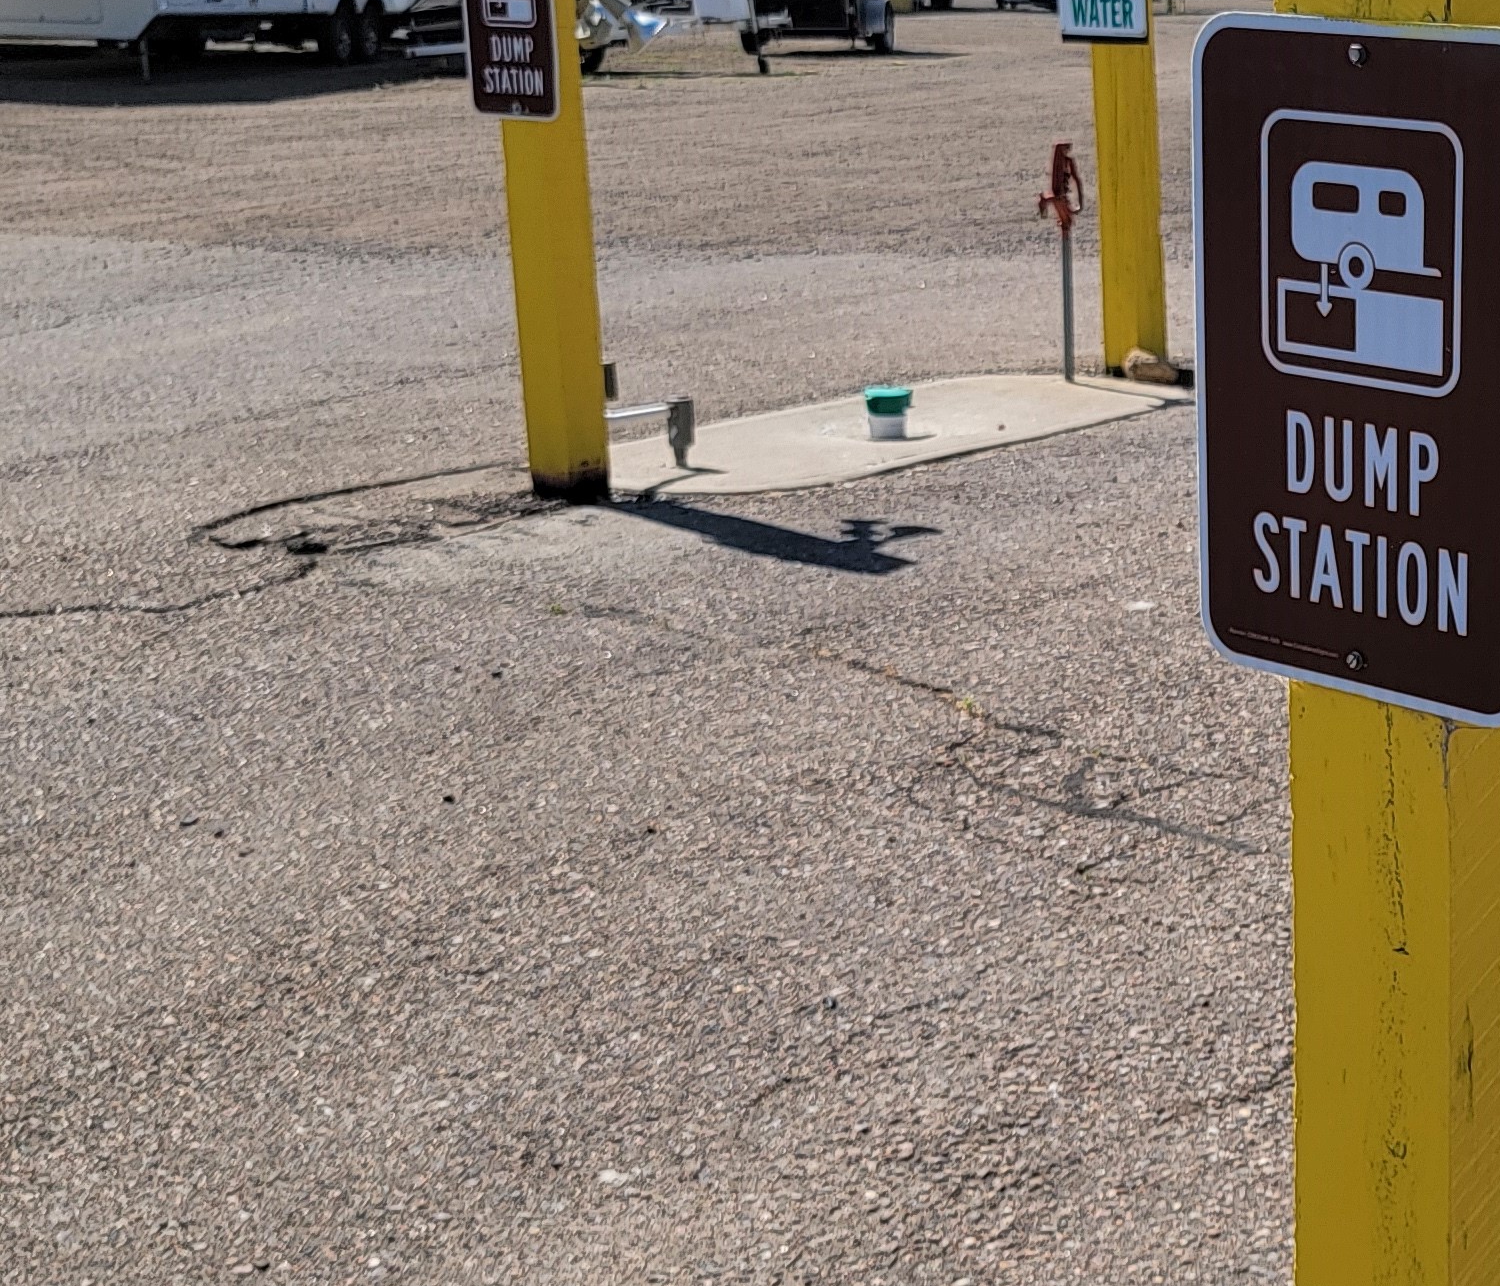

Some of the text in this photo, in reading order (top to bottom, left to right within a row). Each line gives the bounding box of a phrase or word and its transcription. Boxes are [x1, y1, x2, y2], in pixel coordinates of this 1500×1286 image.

[484, 67, 544, 96] STATION
[490, 35, 533, 63] DUMP
[1287, 410, 1439, 516] DUMP
[1253, 511, 1468, 636] STATION
